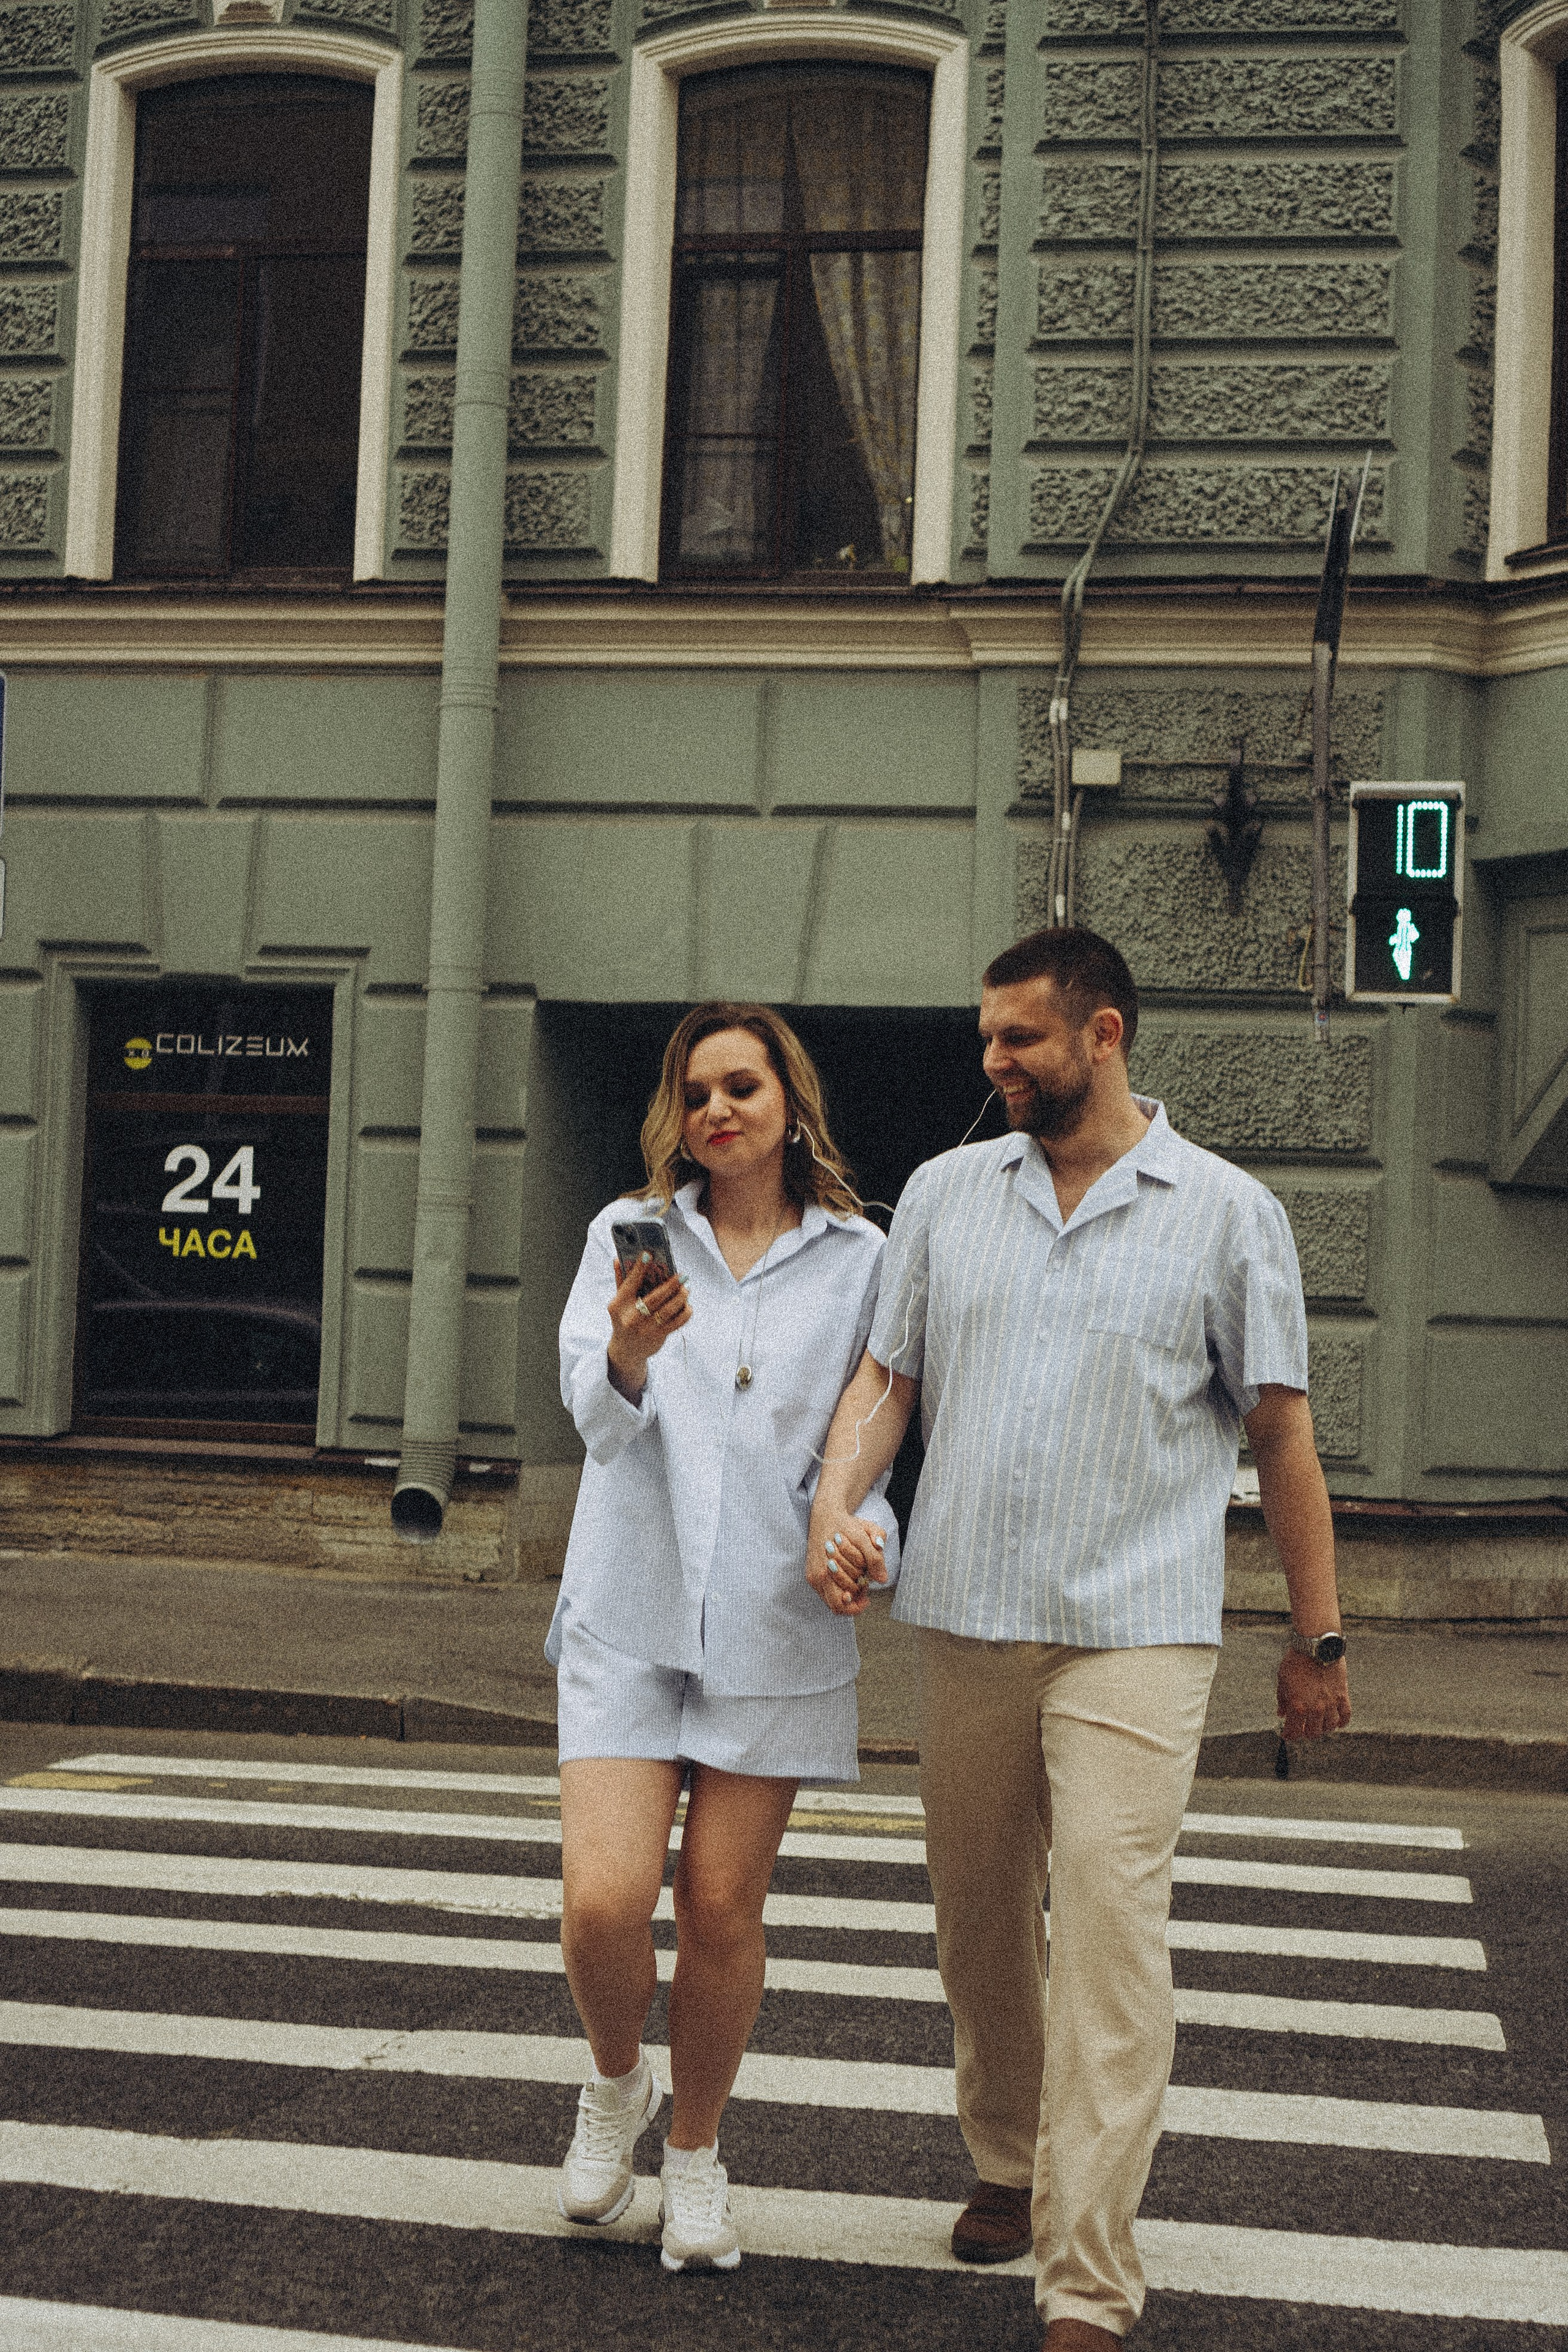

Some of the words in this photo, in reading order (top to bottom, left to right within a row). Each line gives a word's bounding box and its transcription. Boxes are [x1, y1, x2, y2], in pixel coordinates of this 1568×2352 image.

[1396, 802, 1448, 878] 10
[156, 1033, 308, 1057] COLIZEUM
[162, 1144, 261, 1214] 24
[159, 1227, 257, 1259] ЧАСА
